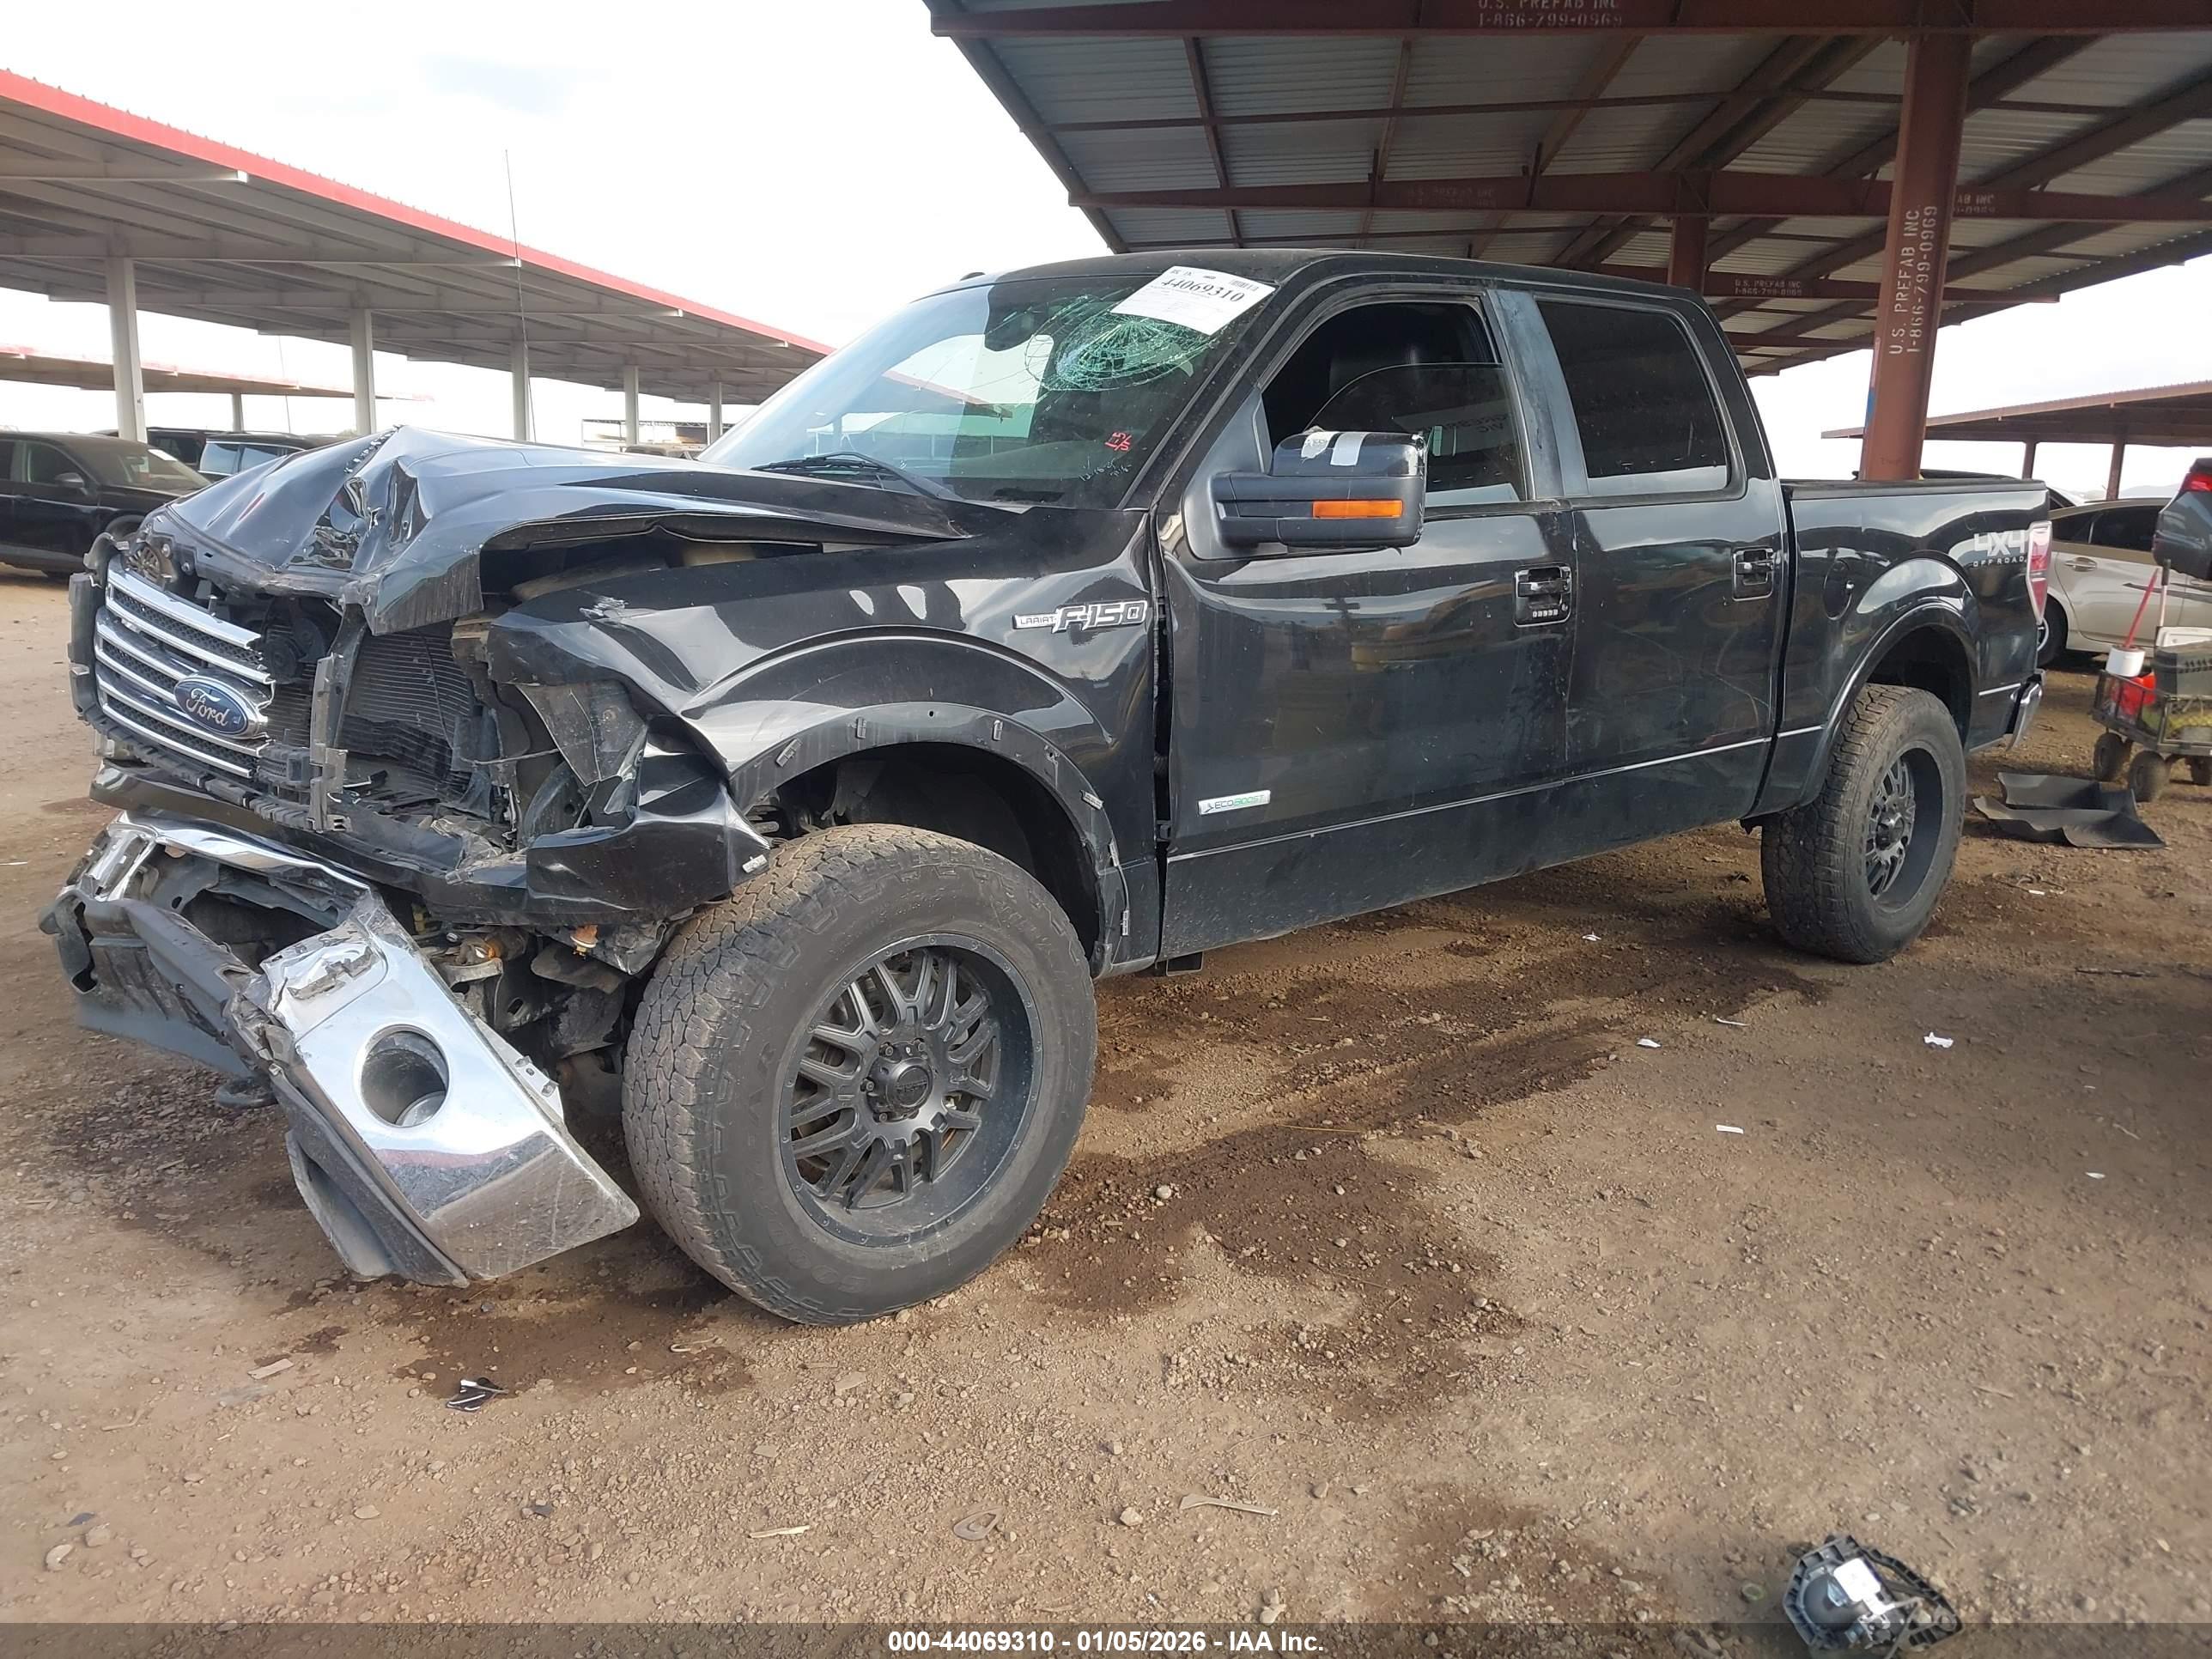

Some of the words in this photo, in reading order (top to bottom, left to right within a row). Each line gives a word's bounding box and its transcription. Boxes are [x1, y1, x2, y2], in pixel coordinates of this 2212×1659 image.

[1161, 277, 1246, 302] 44069310
[1894, 246, 1916, 313] PREFAB
[1906, 205, 1938, 353] 1-866-799-0969
[1889, 322, 1906, 355] U.S.
[1973, 557, 1993, 568] OFF
[1996, 556, 2025, 564] ROAD
[1019, 615, 1055, 626] LARIAT
[1054, 601, 1148, 631] F-150
[185, 688, 230, 726] Ford
[1214, 794, 1265, 810] ECOBOOST
